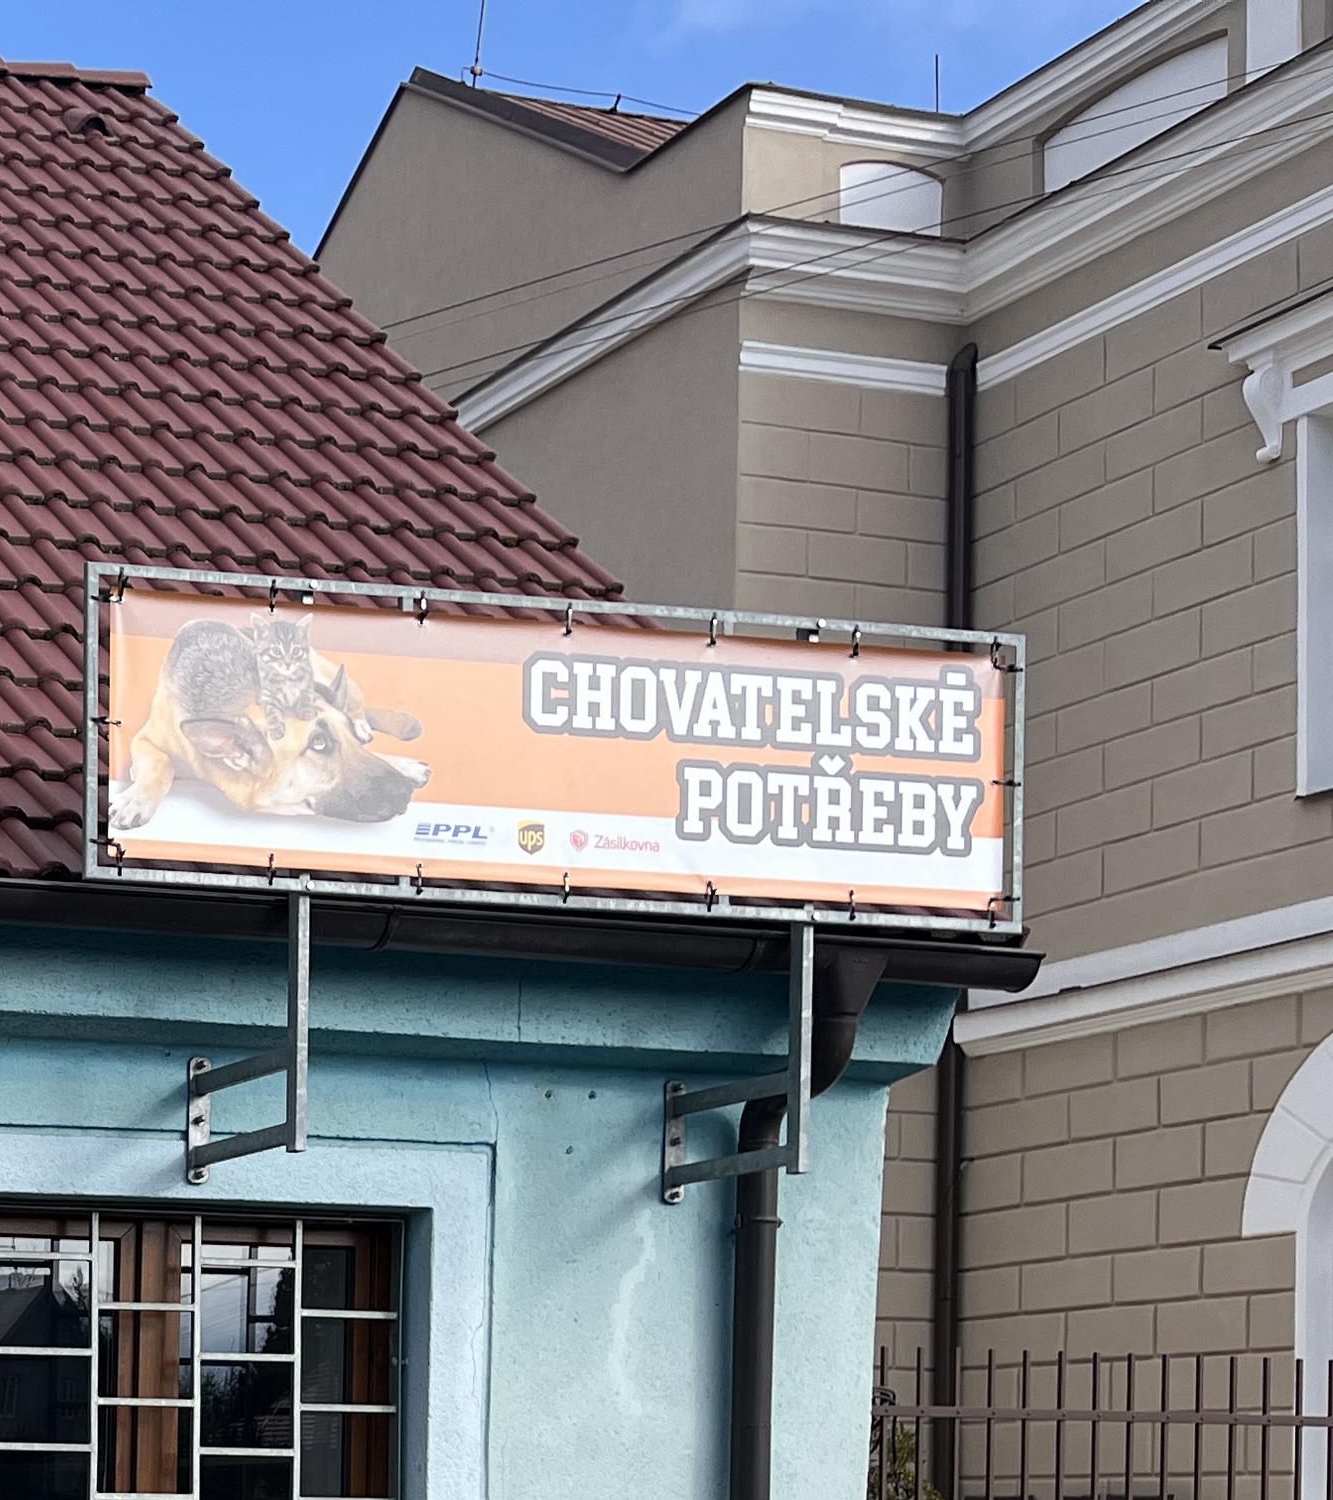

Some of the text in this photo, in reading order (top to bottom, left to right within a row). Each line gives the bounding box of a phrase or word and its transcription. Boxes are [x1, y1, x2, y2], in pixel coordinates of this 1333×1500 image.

[527, 656, 978, 758] CHOVATELSKÉ
[680, 752, 980, 853] POTŘEBY
[431, 823, 488, 840] PPL
[520, 833, 544, 851] ups
[594, 834, 660, 852] Zásilkovna
